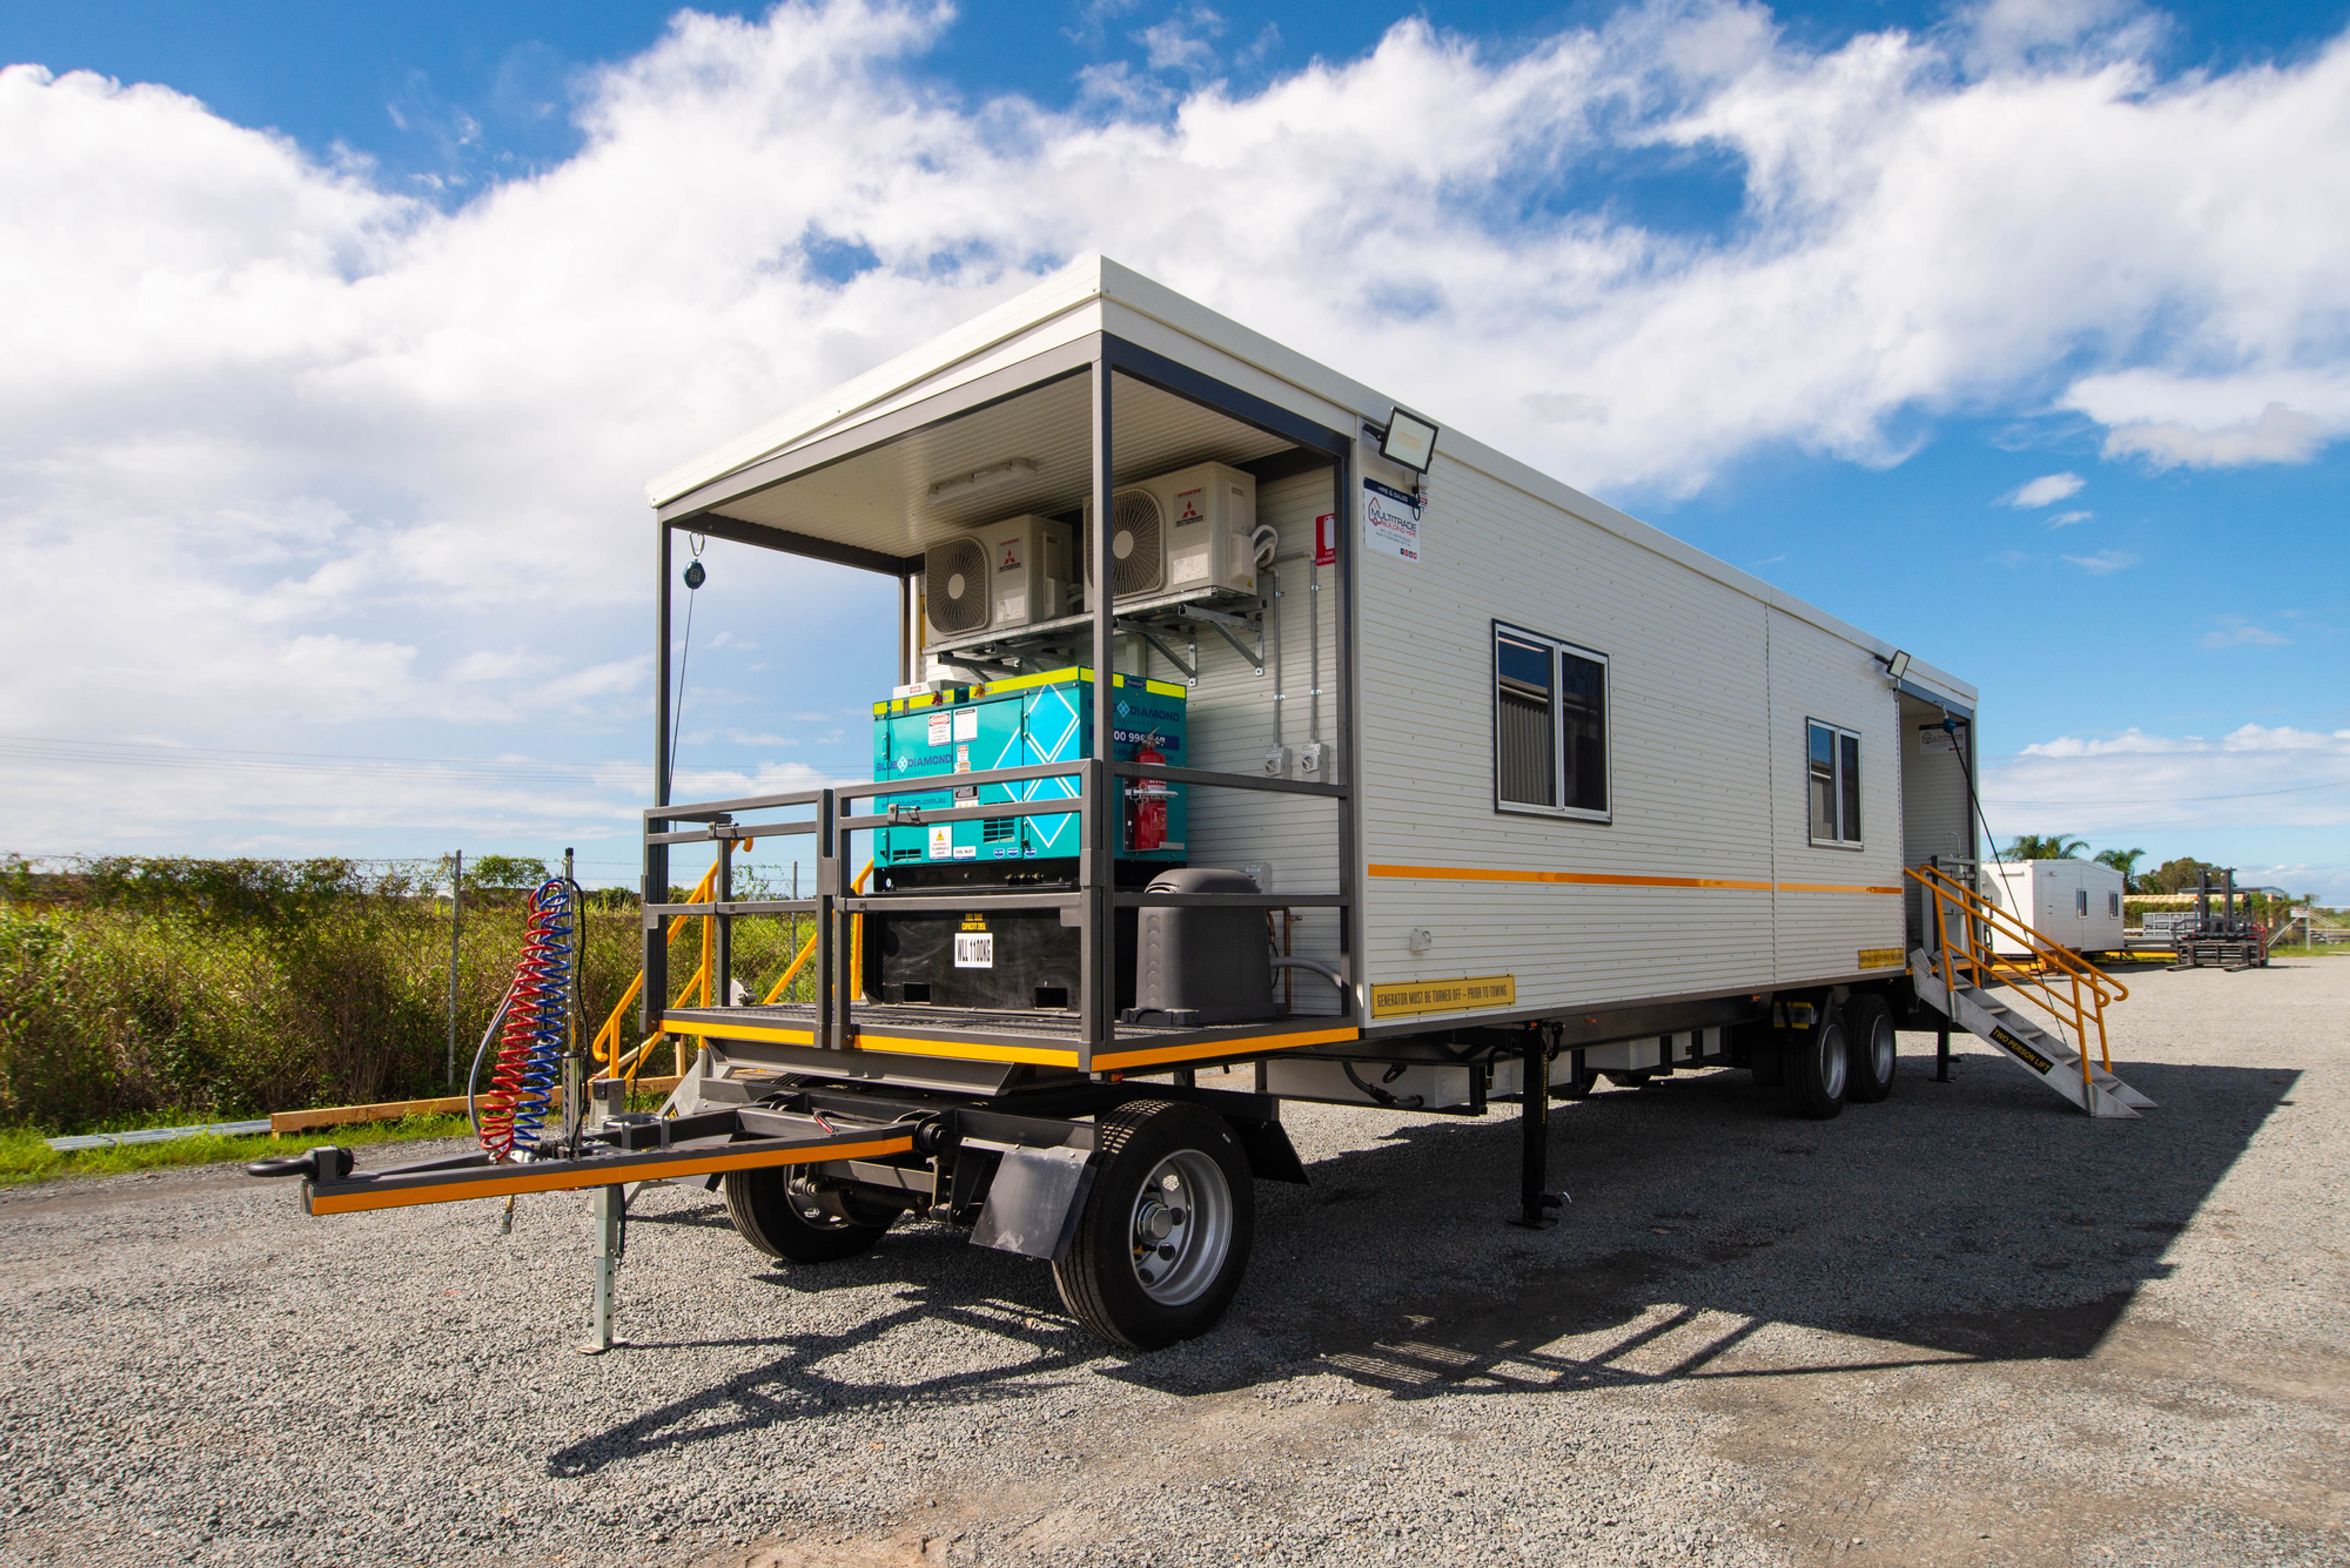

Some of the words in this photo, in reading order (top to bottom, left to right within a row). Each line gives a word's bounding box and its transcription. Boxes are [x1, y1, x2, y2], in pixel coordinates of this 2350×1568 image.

[1394, 490, 1408, 503] SALES
[1371, 508, 1417, 532] MULTITRADE
[1130, 705, 1180, 722] DIAMOND
[876, 760, 897, 771] BLUE
[908, 754, 952, 767] DIAMOND
[1377, 992, 1408, 1007] GENERATOR
[1409, 991, 1423, 1004] MUST
[1425, 990, 1431, 1003] BE
[1432, 989, 1451, 1002] TURNED
[1452, 988, 1461, 1001] OFF
[1468, 986, 1481, 999] PRIOR
[1482, 986, 1488, 998] TO
[1489, 984, 1507, 997] TOWING
[1993, 1029, 2009, 1043] TWO
[2008, 1039, 2036, 1062] PERSON
[2034, 1058, 2051, 1071] LIFT
